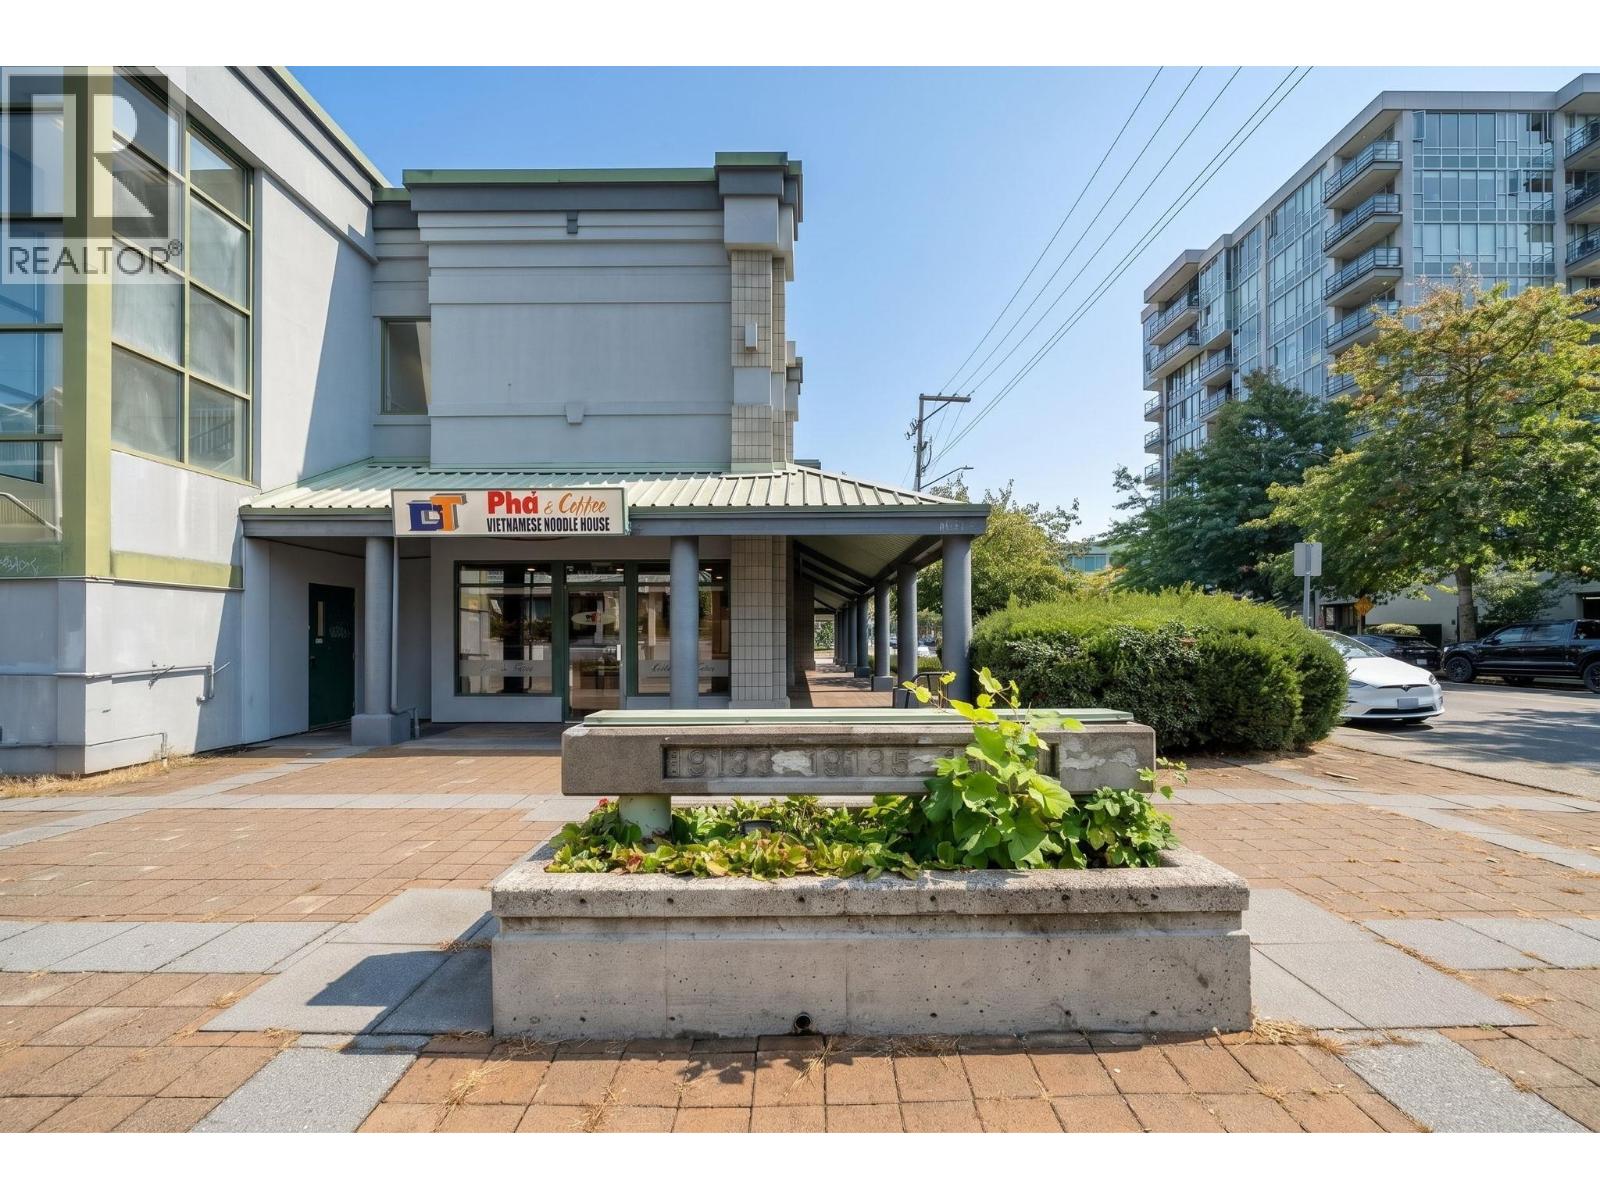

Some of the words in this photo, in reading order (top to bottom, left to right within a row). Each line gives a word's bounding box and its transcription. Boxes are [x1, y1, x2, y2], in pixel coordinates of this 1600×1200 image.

[558, 492, 607, 516] Coffee
[487, 517, 542, 532] VIETNAMESE
[544, 517, 578, 532] NOODLE
[580, 517, 610, 532] HOUSE
